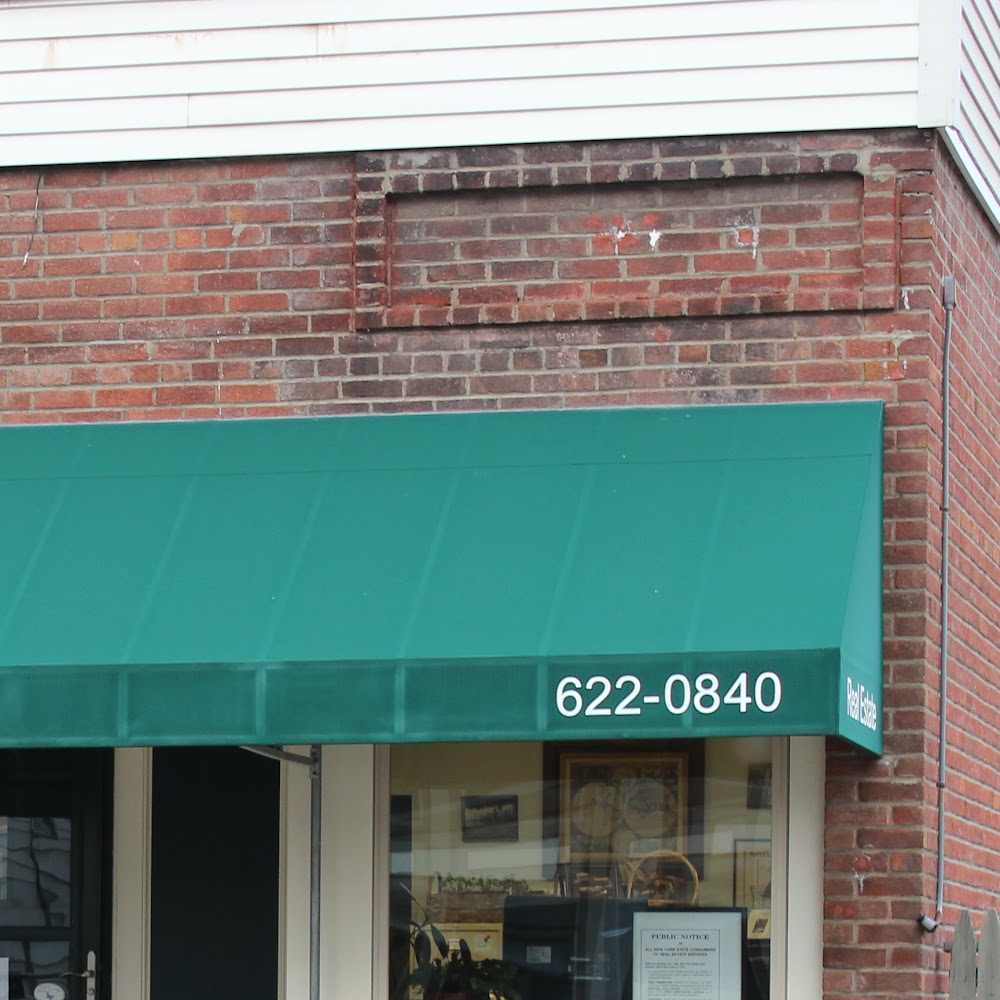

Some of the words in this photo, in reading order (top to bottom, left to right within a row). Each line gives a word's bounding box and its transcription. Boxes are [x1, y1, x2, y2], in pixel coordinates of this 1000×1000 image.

[556, 671, 783, 717] 622-0840
[846, 676, 860, 721] Real
[860, 684, 877, 732] Estate
